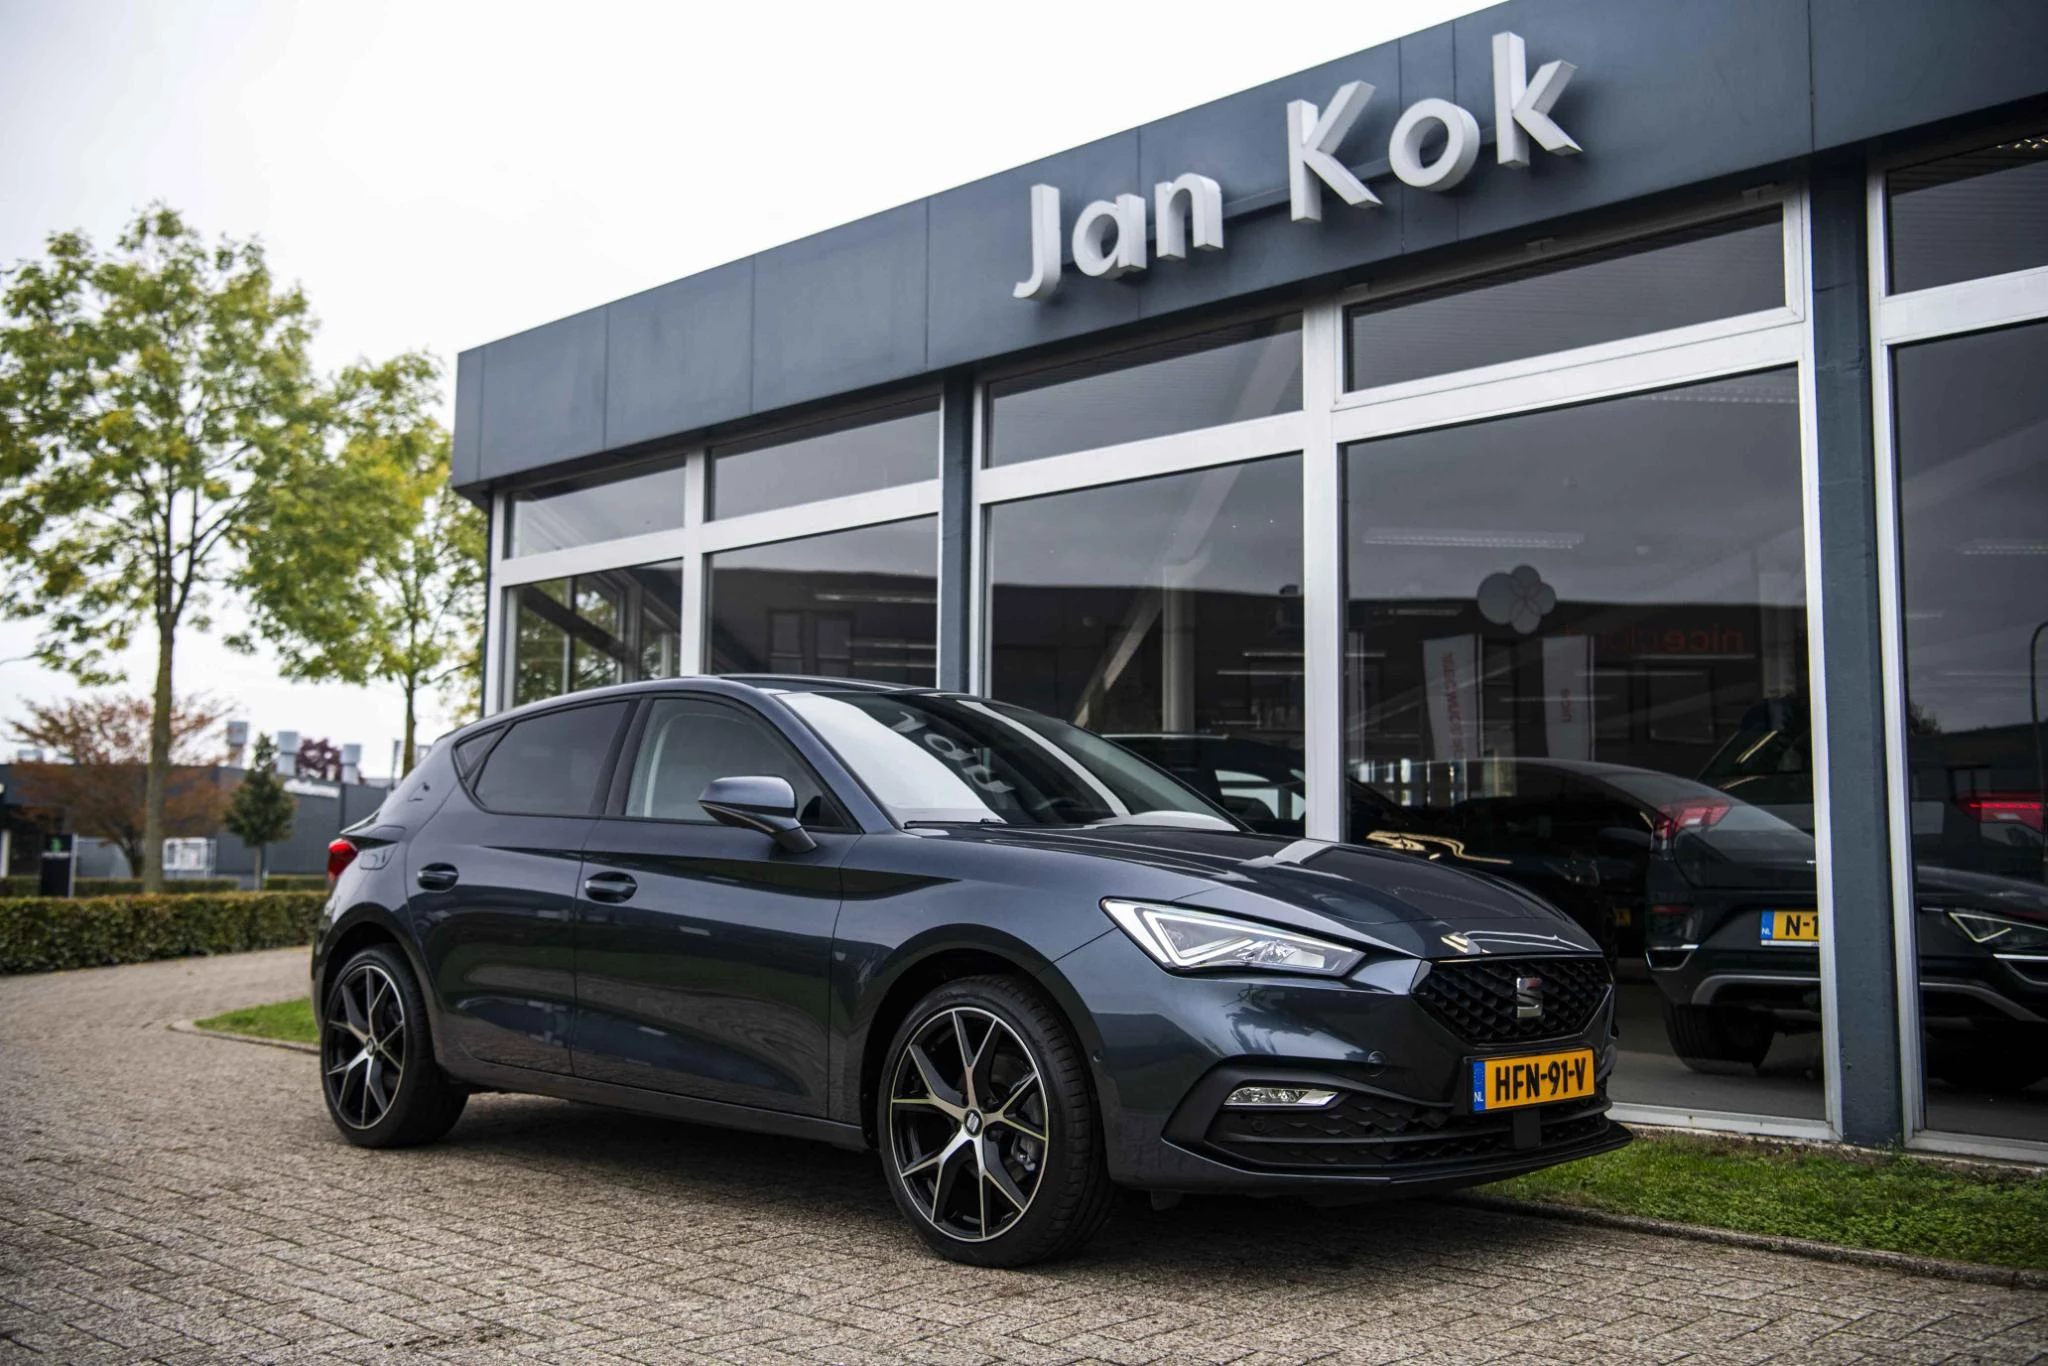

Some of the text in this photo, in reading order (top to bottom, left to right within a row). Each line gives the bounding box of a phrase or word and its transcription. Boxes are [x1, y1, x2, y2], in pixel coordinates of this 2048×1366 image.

[1013, 31, 1583, 299] Jan Kok
[1474, 1091, 1484, 1102] NL
[1495, 1057, 1587, 1103] HFN-91-V
